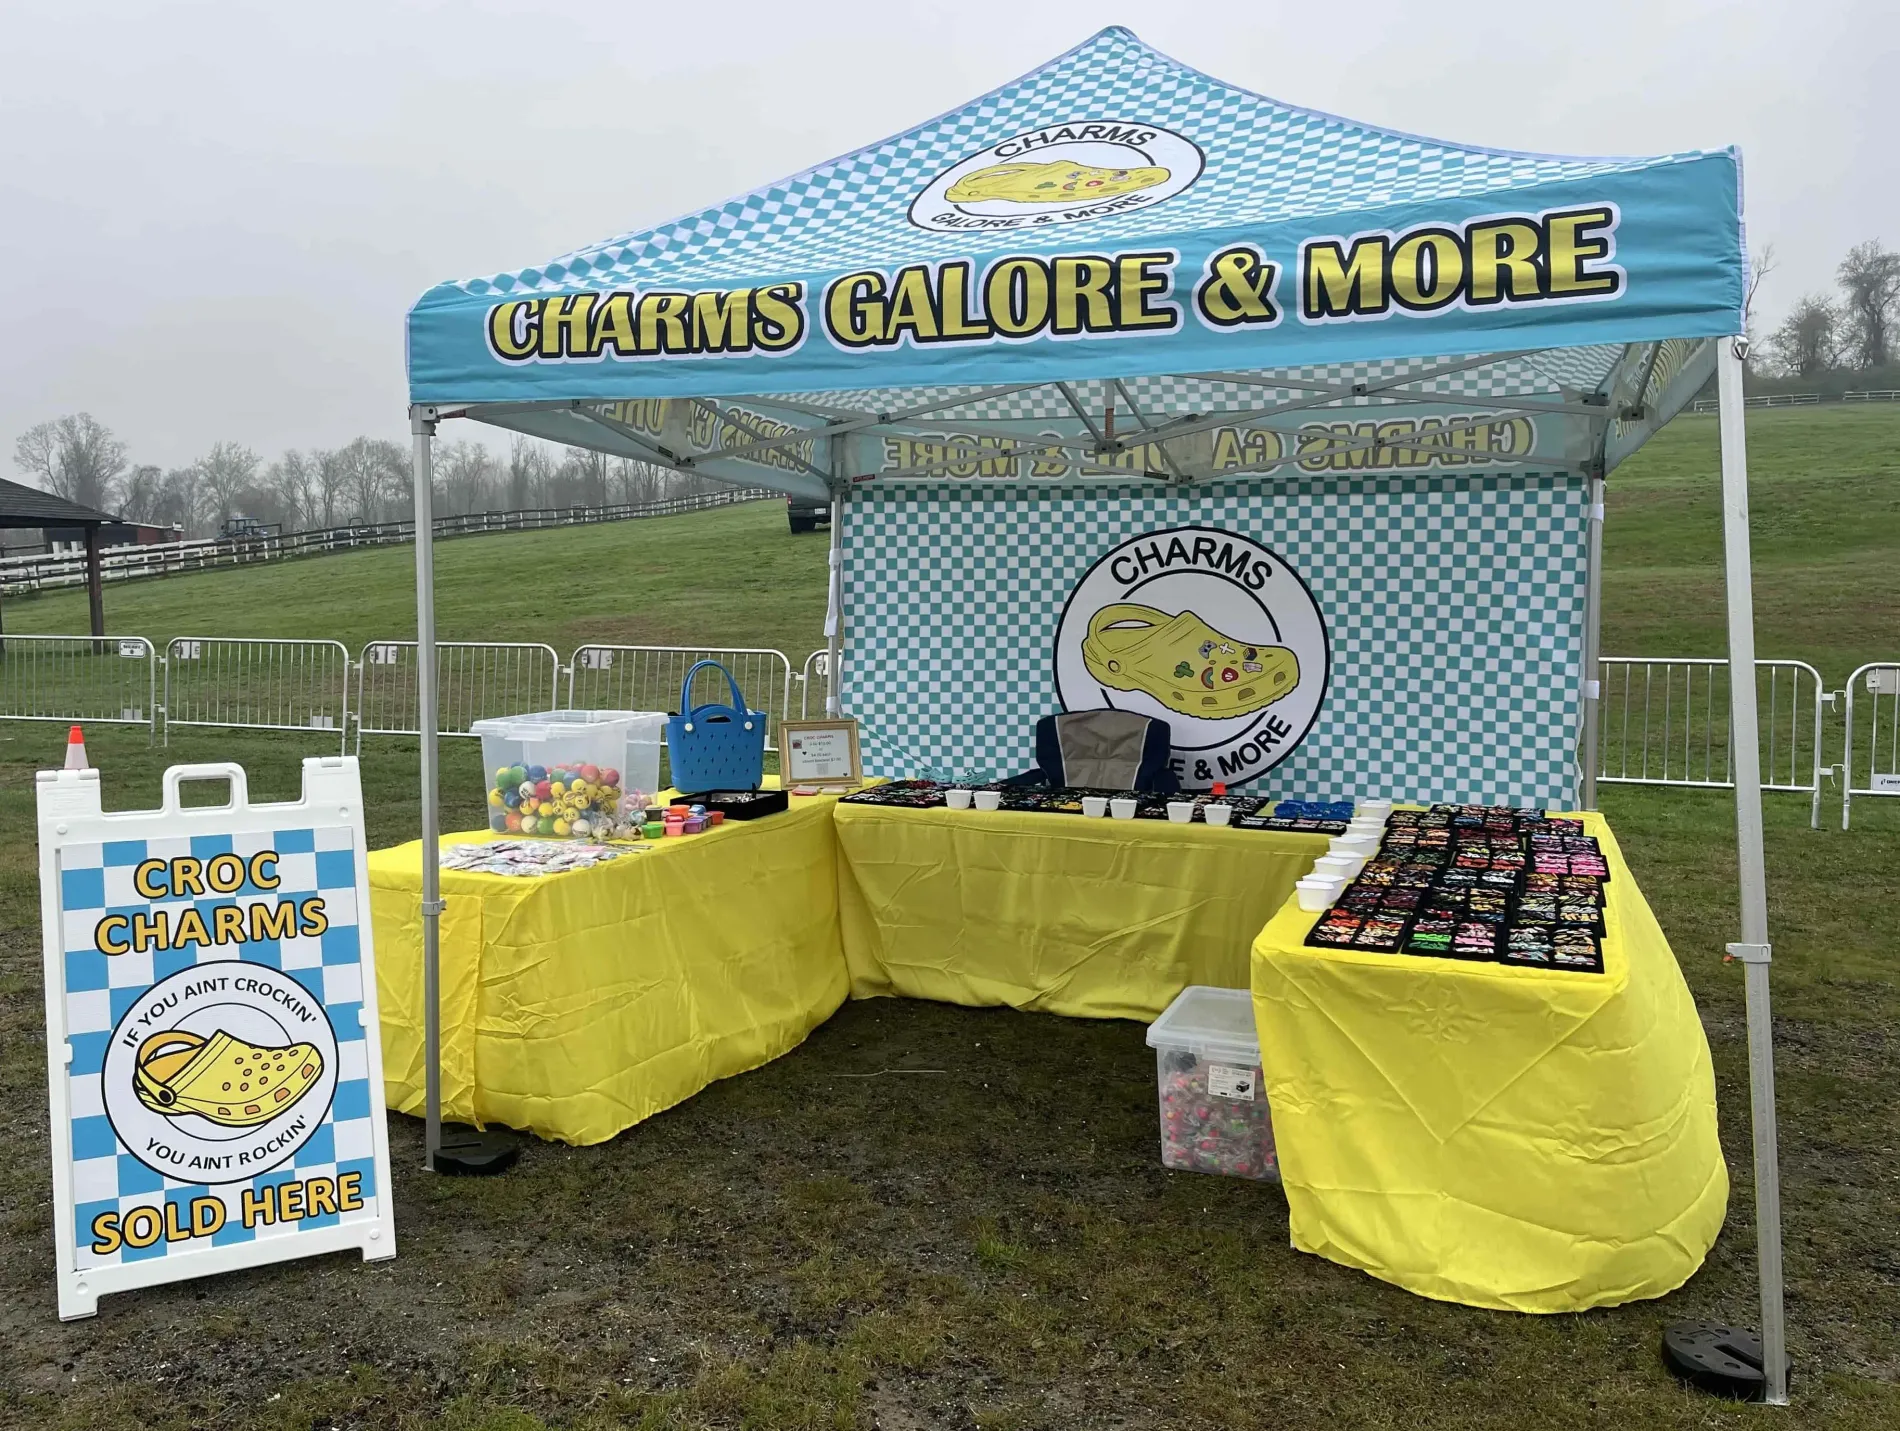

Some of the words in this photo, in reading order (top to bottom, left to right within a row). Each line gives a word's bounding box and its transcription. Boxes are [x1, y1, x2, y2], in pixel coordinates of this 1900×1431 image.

[994, 124, 1157, 157] CHARMS
[931, 213, 1022, 228] GALORE
[1033, 215, 1053, 224] &
[1064, 195, 1153, 220] MORE
[487, 282, 805, 361] CHARMS
[827, 250, 1179, 347] GALORE
[1198, 246, 1279, 328] &
[1301, 206, 1621, 319] MORE
[1111, 536, 1273, 590] CHARMS
[1193, 758, 1213, 781] &
[1217, 714, 1292, 776] MORE
[133, 851, 280, 898] CROC
[94, 898, 329, 956] CHARMS
[122, 1026, 140, 1049] IF
[138, 992, 179, 1027] YOU
[184, 977, 230, 996] AINT
[234, 976, 317, 1023] CROCKIN'
[145, 1136, 186, 1167] YOU
[188, 1153, 234, 1170] AINT
[238, 1114, 307, 1166] ROCKIN'
[91, 1196, 227, 1255] SOLD
[241, 1172, 364, 1230] HERE
